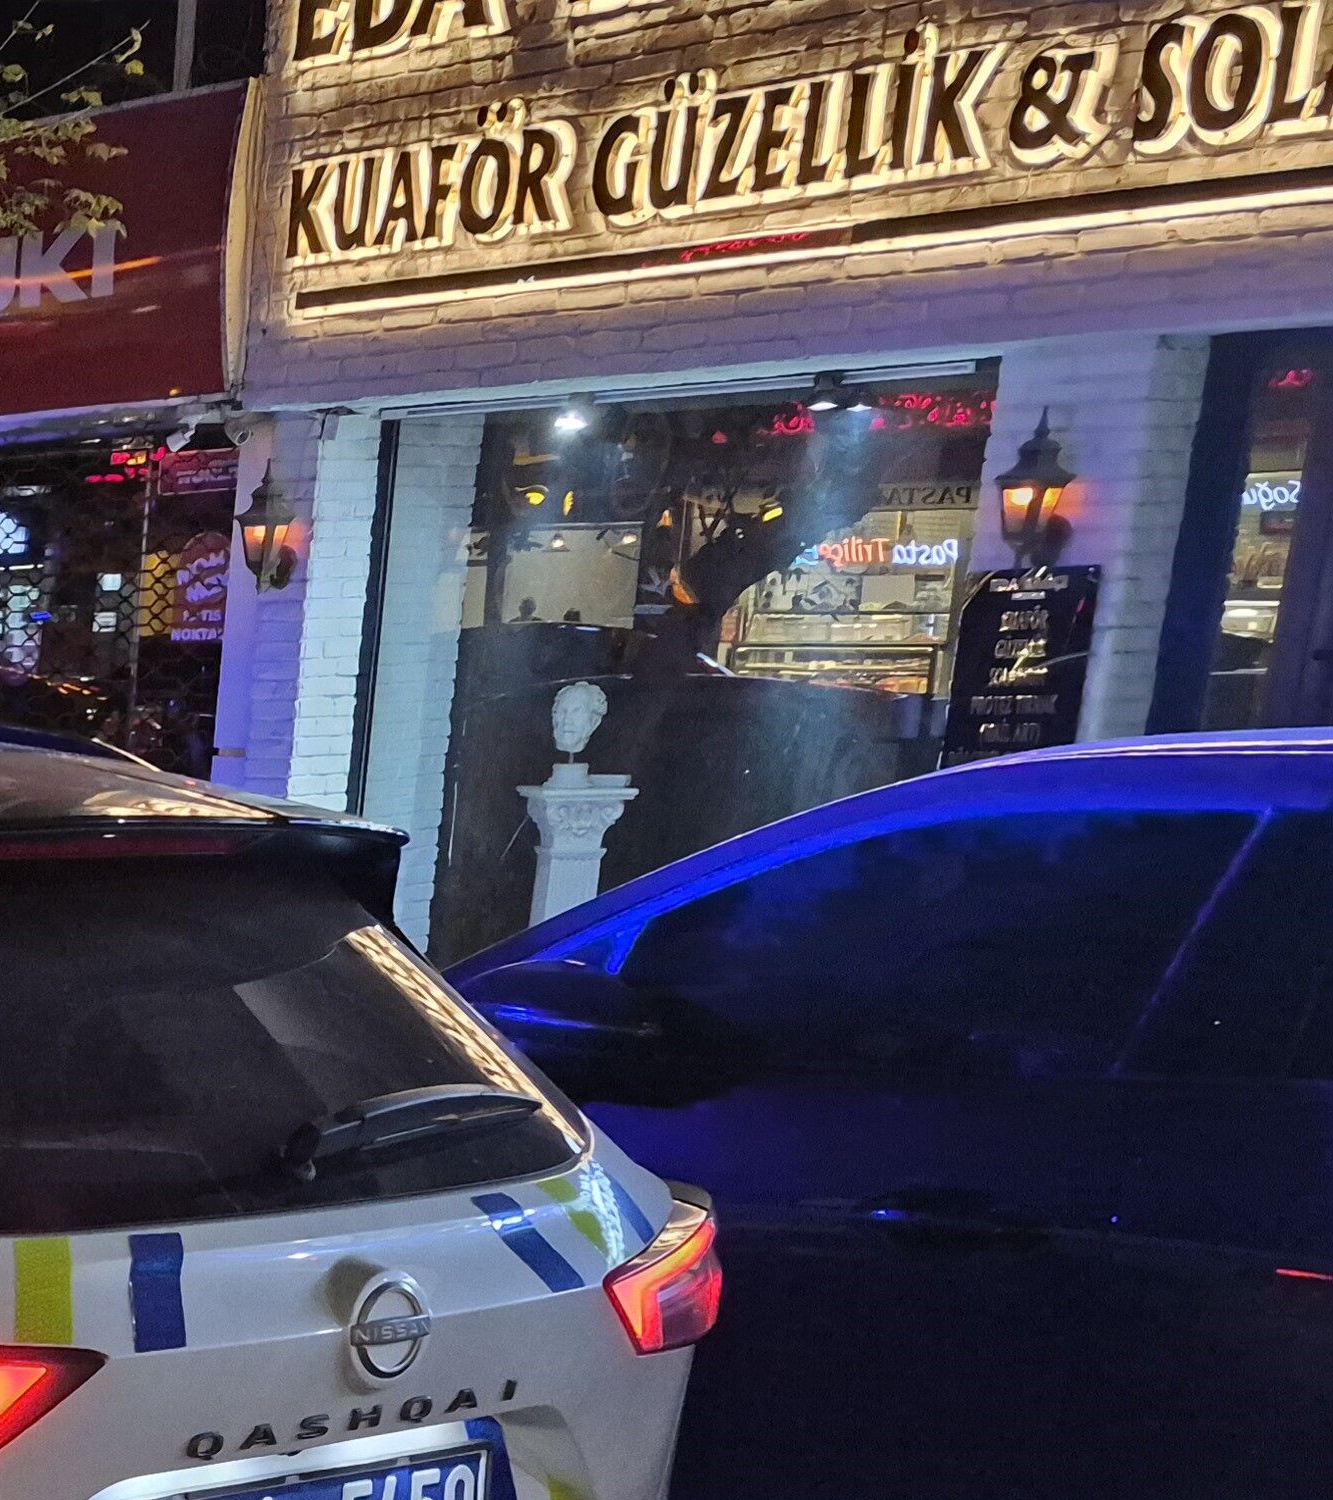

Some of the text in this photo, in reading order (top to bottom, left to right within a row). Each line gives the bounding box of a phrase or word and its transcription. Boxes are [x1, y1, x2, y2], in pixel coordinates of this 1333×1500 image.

[286, 4, 1333, 260] KUAFÖR GÜZELLİK & SOL
[185, 1378, 518, 1461] QASHQAI
